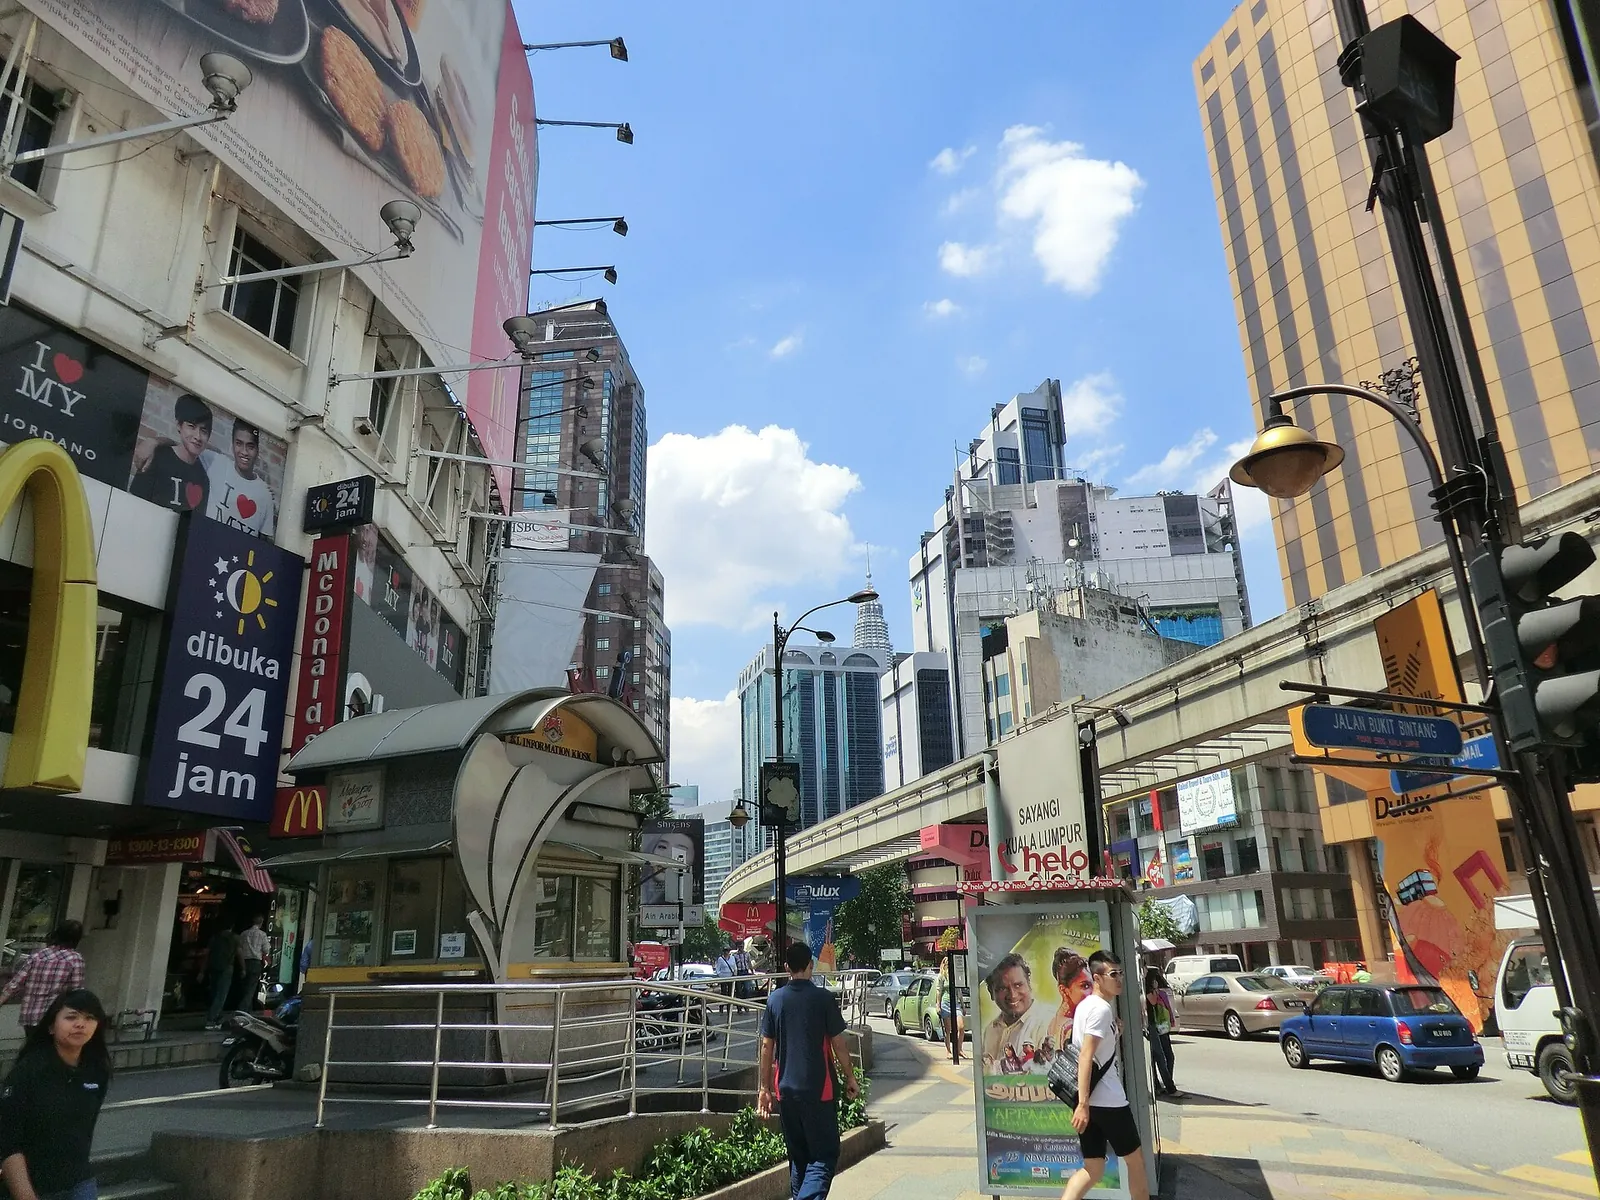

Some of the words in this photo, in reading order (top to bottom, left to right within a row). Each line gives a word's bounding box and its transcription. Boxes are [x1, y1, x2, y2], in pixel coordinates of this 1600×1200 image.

[15, 366, 87, 418] MY
[3, 412, 97, 462] IORDANO
[336, 488, 360, 508] 24
[337, 481, 360, 491] dibuka
[335, 507, 356, 520] jam
[186, 630, 279, 681] dibuka
[177, 672, 269, 757] 24
[1333, 712, 1366, 731] JALAN
[1368, 716, 1396, 735] BUKIT
[1398, 719, 1438, 739] BINTANG
[522, 737, 572, 757] INFORMATION
[571, 747, 592, 761] KIOSK
[168, 751, 257, 800] jam
[1018, 798, 1061, 826] SAYANGI
[1005, 832, 1037, 856] KUALA
[1039, 823, 1083, 849] LUMPUR
[1023, 844, 1088, 873] helo
[1054, 881, 1070, 889] helo
[1098, 879, 1113, 888] helo
[644, 912, 657, 920] Ain
[1062, 928, 1081, 939] RAJA
[1023, 1151, 1080, 1164] NOVEMBER
